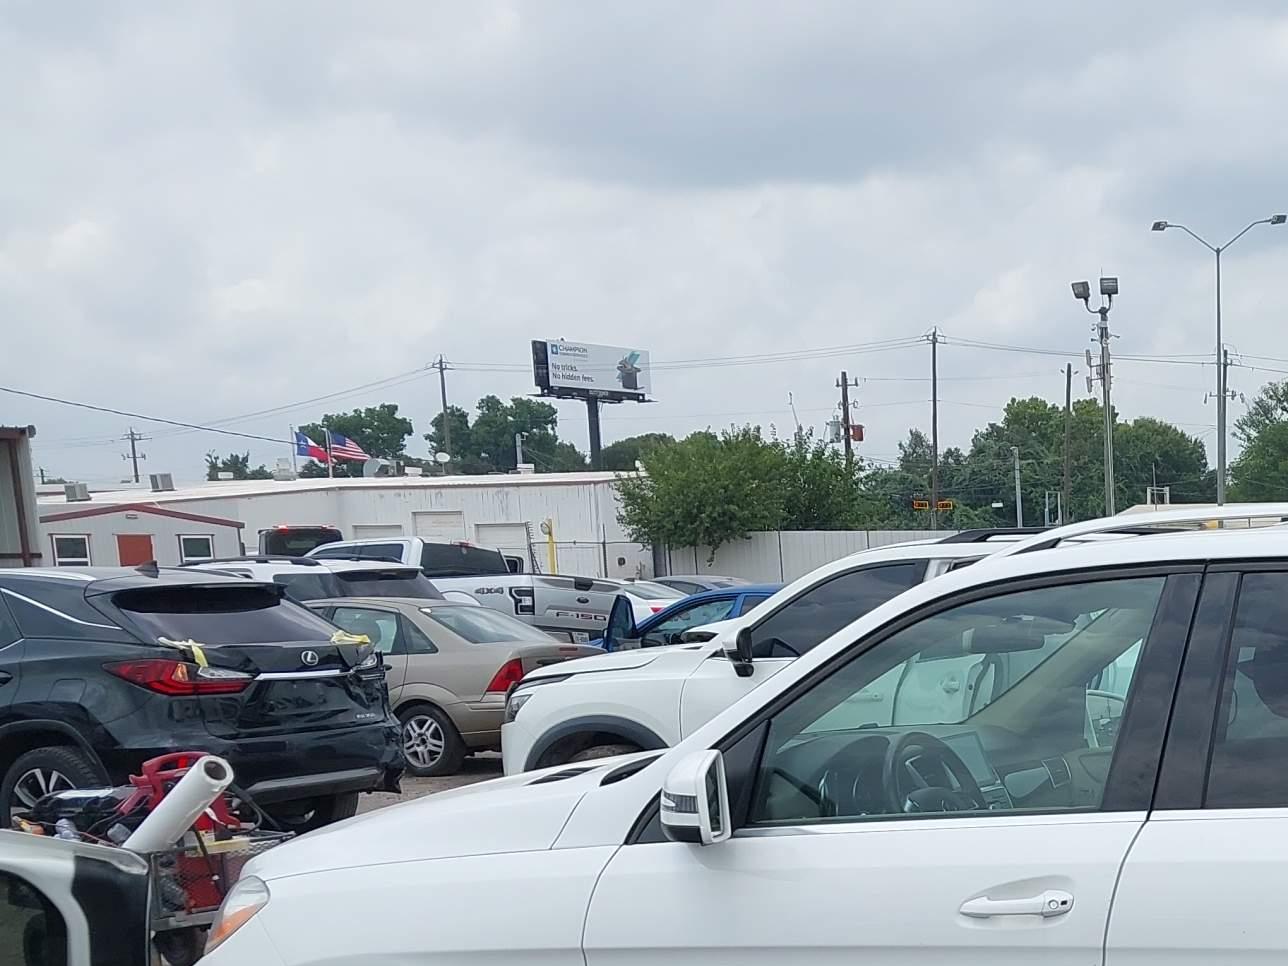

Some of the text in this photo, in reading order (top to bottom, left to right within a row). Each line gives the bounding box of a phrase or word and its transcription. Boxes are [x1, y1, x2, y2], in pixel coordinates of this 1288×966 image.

[551, 363, 578, 372] No tricks.
[552, 372, 594, 382] No hidden fees.
[556, 611, 607, 622] F-150
